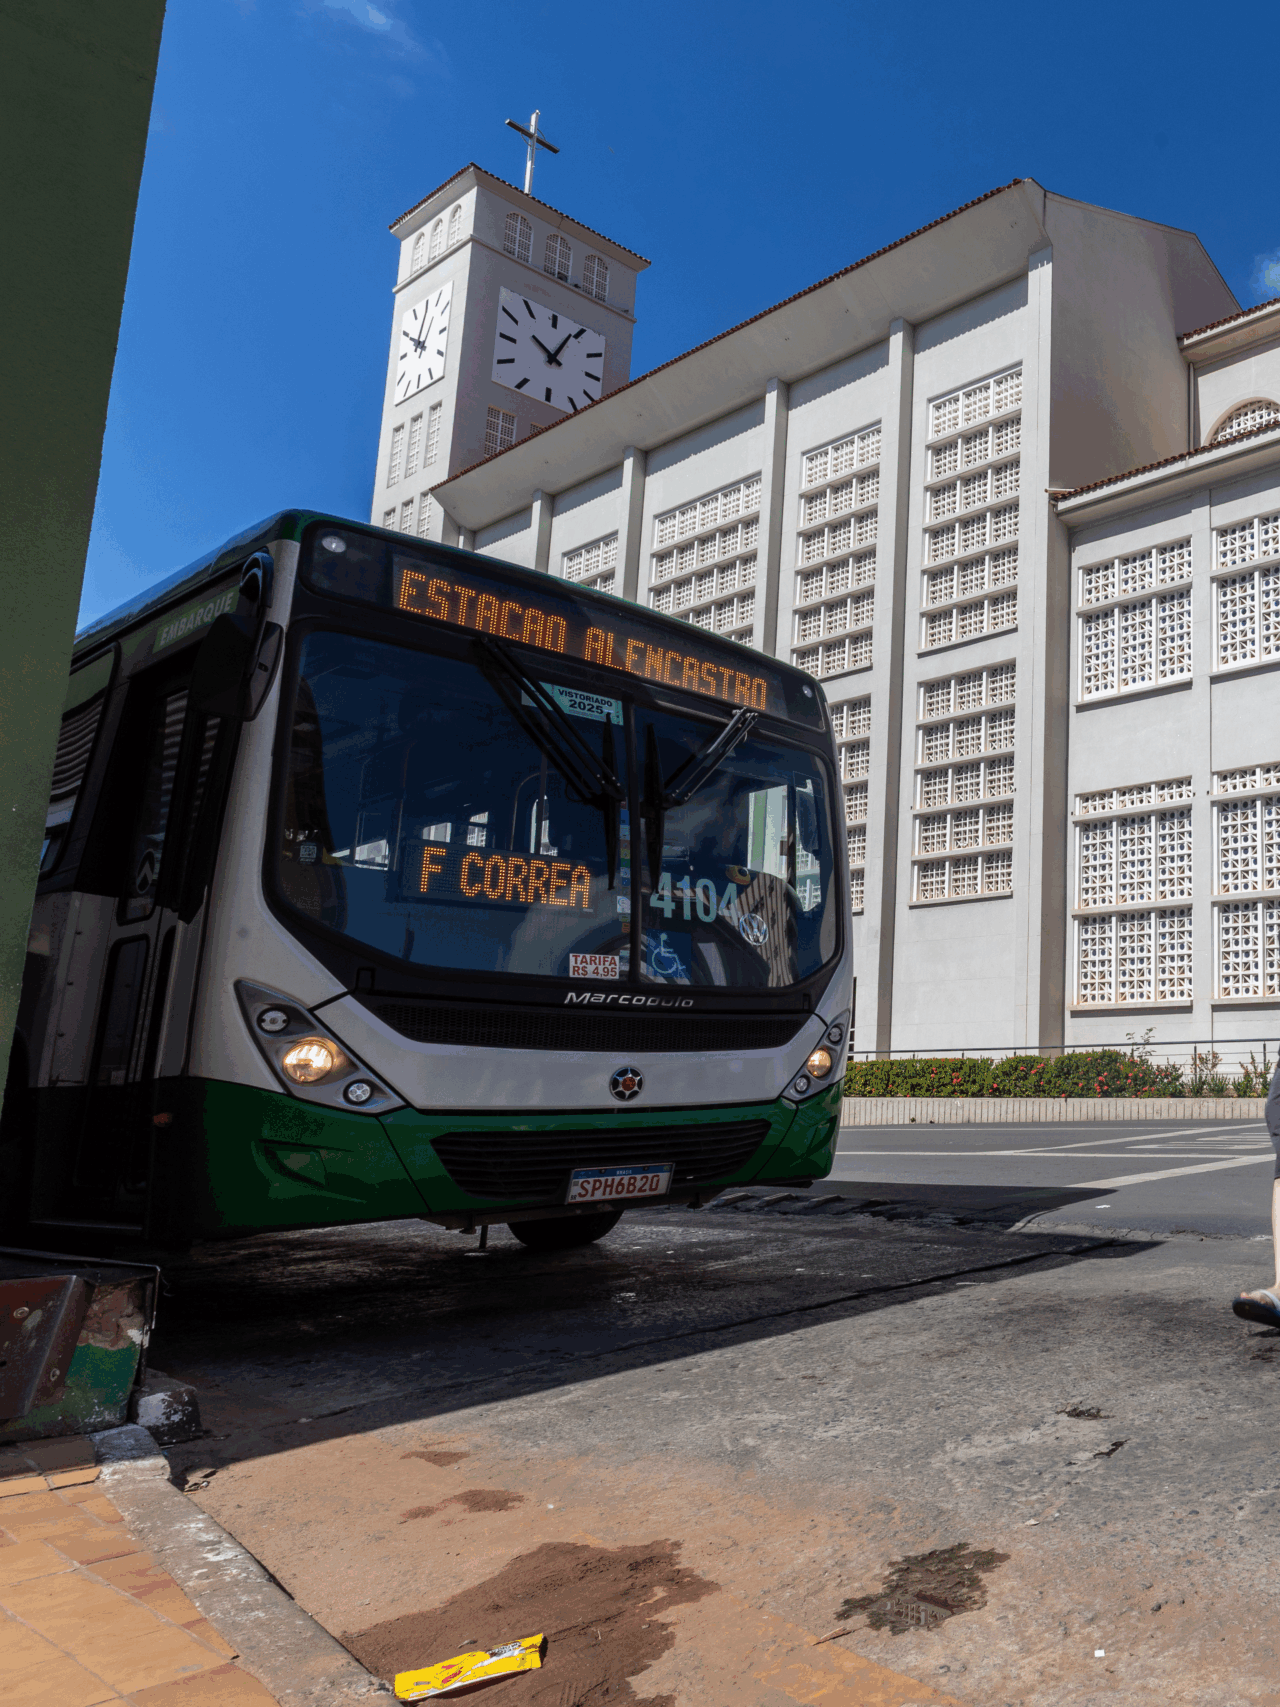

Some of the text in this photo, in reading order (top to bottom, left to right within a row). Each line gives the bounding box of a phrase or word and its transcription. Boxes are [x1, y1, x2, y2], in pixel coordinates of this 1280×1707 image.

[160, 591, 234, 647] EMBARQUE
[399, 569, 768, 711] ESTACAO ALENCASTRO
[558, 688, 613, 707] VISTORIADO
[568, 699, 604, 715] 2025
[420, 846, 592, 908] F CORREA
[650, 872, 738, 927] 4104
[572, 954, 617, 967] TARIFA
[572, 966, 618, 978] R$ 4,95
[564, 991, 694, 1008] Marcopolo
[577, 1174, 661, 1199] SPH6B20
